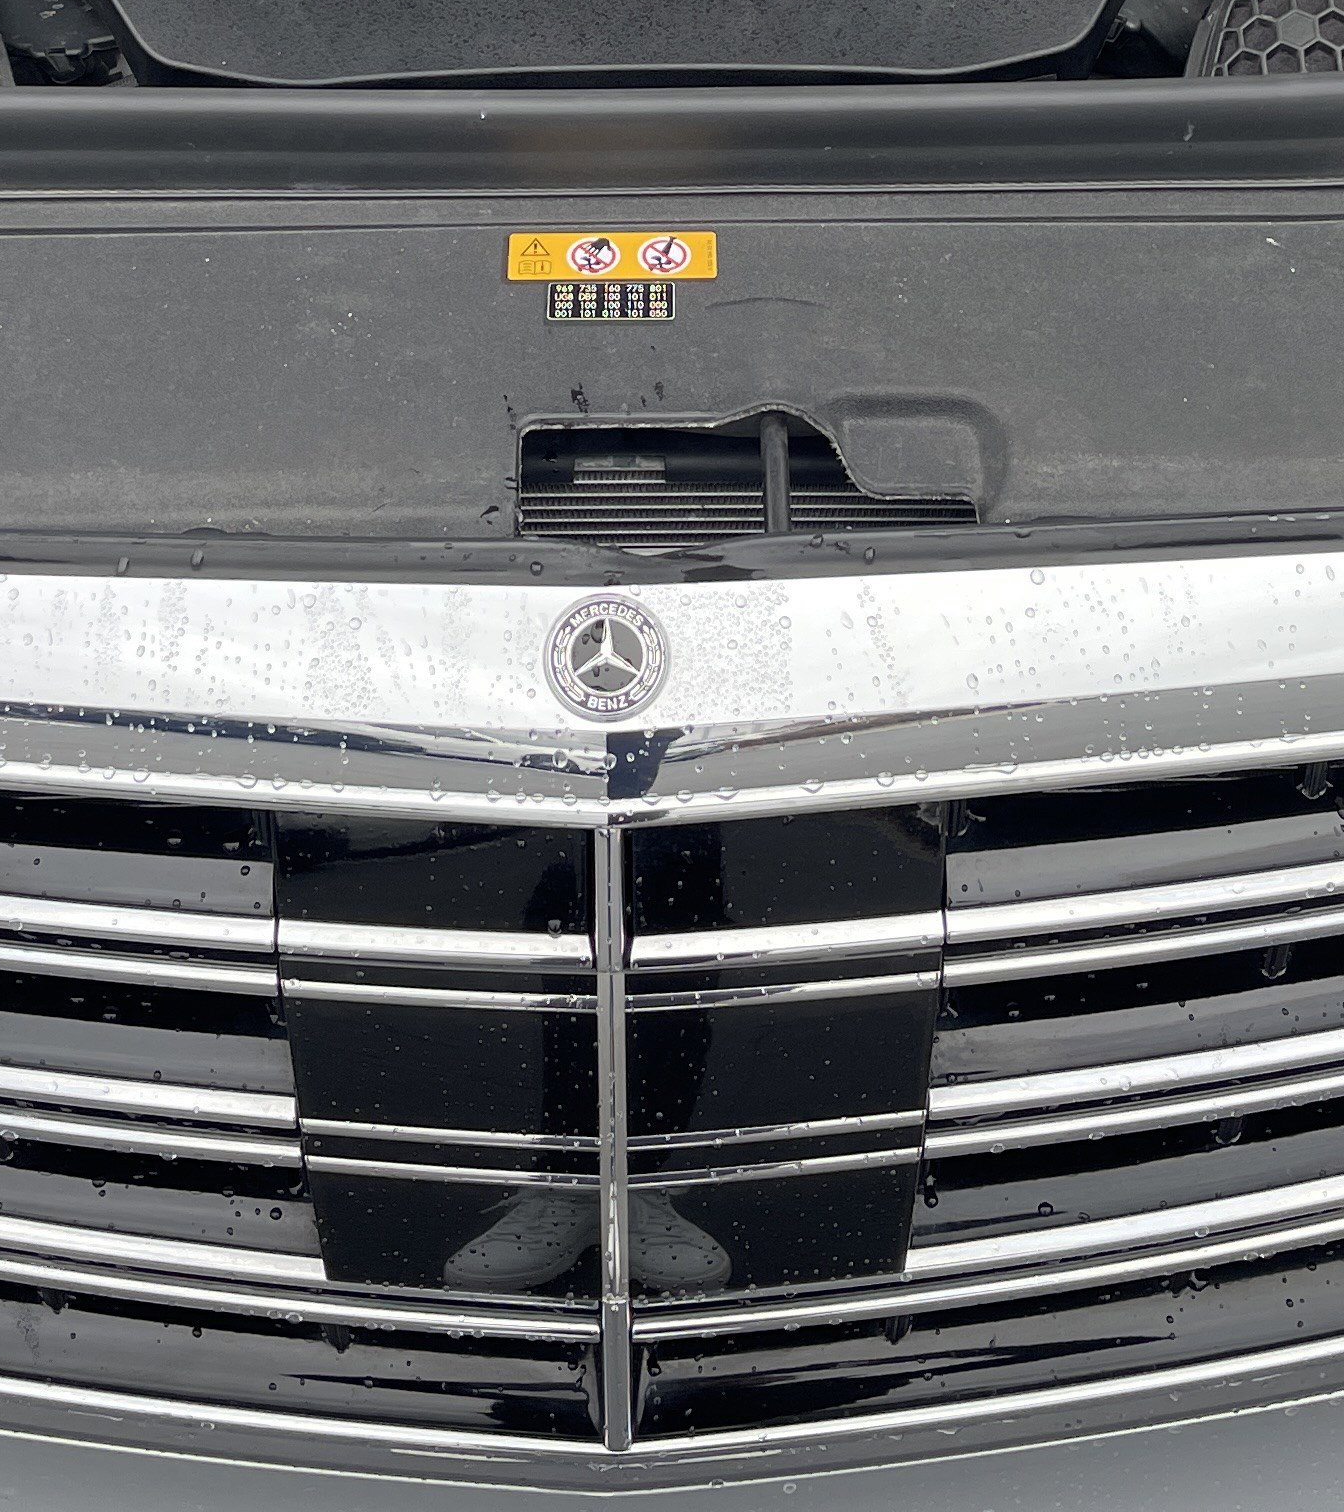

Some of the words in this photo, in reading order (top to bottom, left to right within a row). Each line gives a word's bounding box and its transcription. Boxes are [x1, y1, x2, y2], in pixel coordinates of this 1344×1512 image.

[556, 284, 574, 293] 969
[604, 284, 621, 293] 160
[604, 292, 621, 301] 100
[627, 292, 644, 301] 101
[649, 292, 667, 301] 011
[555, 301, 574, 309] 000
[580, 301, 597, 309] 100
[604, 301, 621, 309] 100
[627, 301, 645, 309] 110
[649, 301, 668, 309] 000
[554, 309, 572, 318] 001
[580, 309, 596, 318] 101
[601, 309, 621, 318] 010
[627, 309, 644, 318] 101
[649, 309, 668, 318] 050
[569, 602, 645, 627] MERCEDES
[587, 693, 629, 711] BENZ
